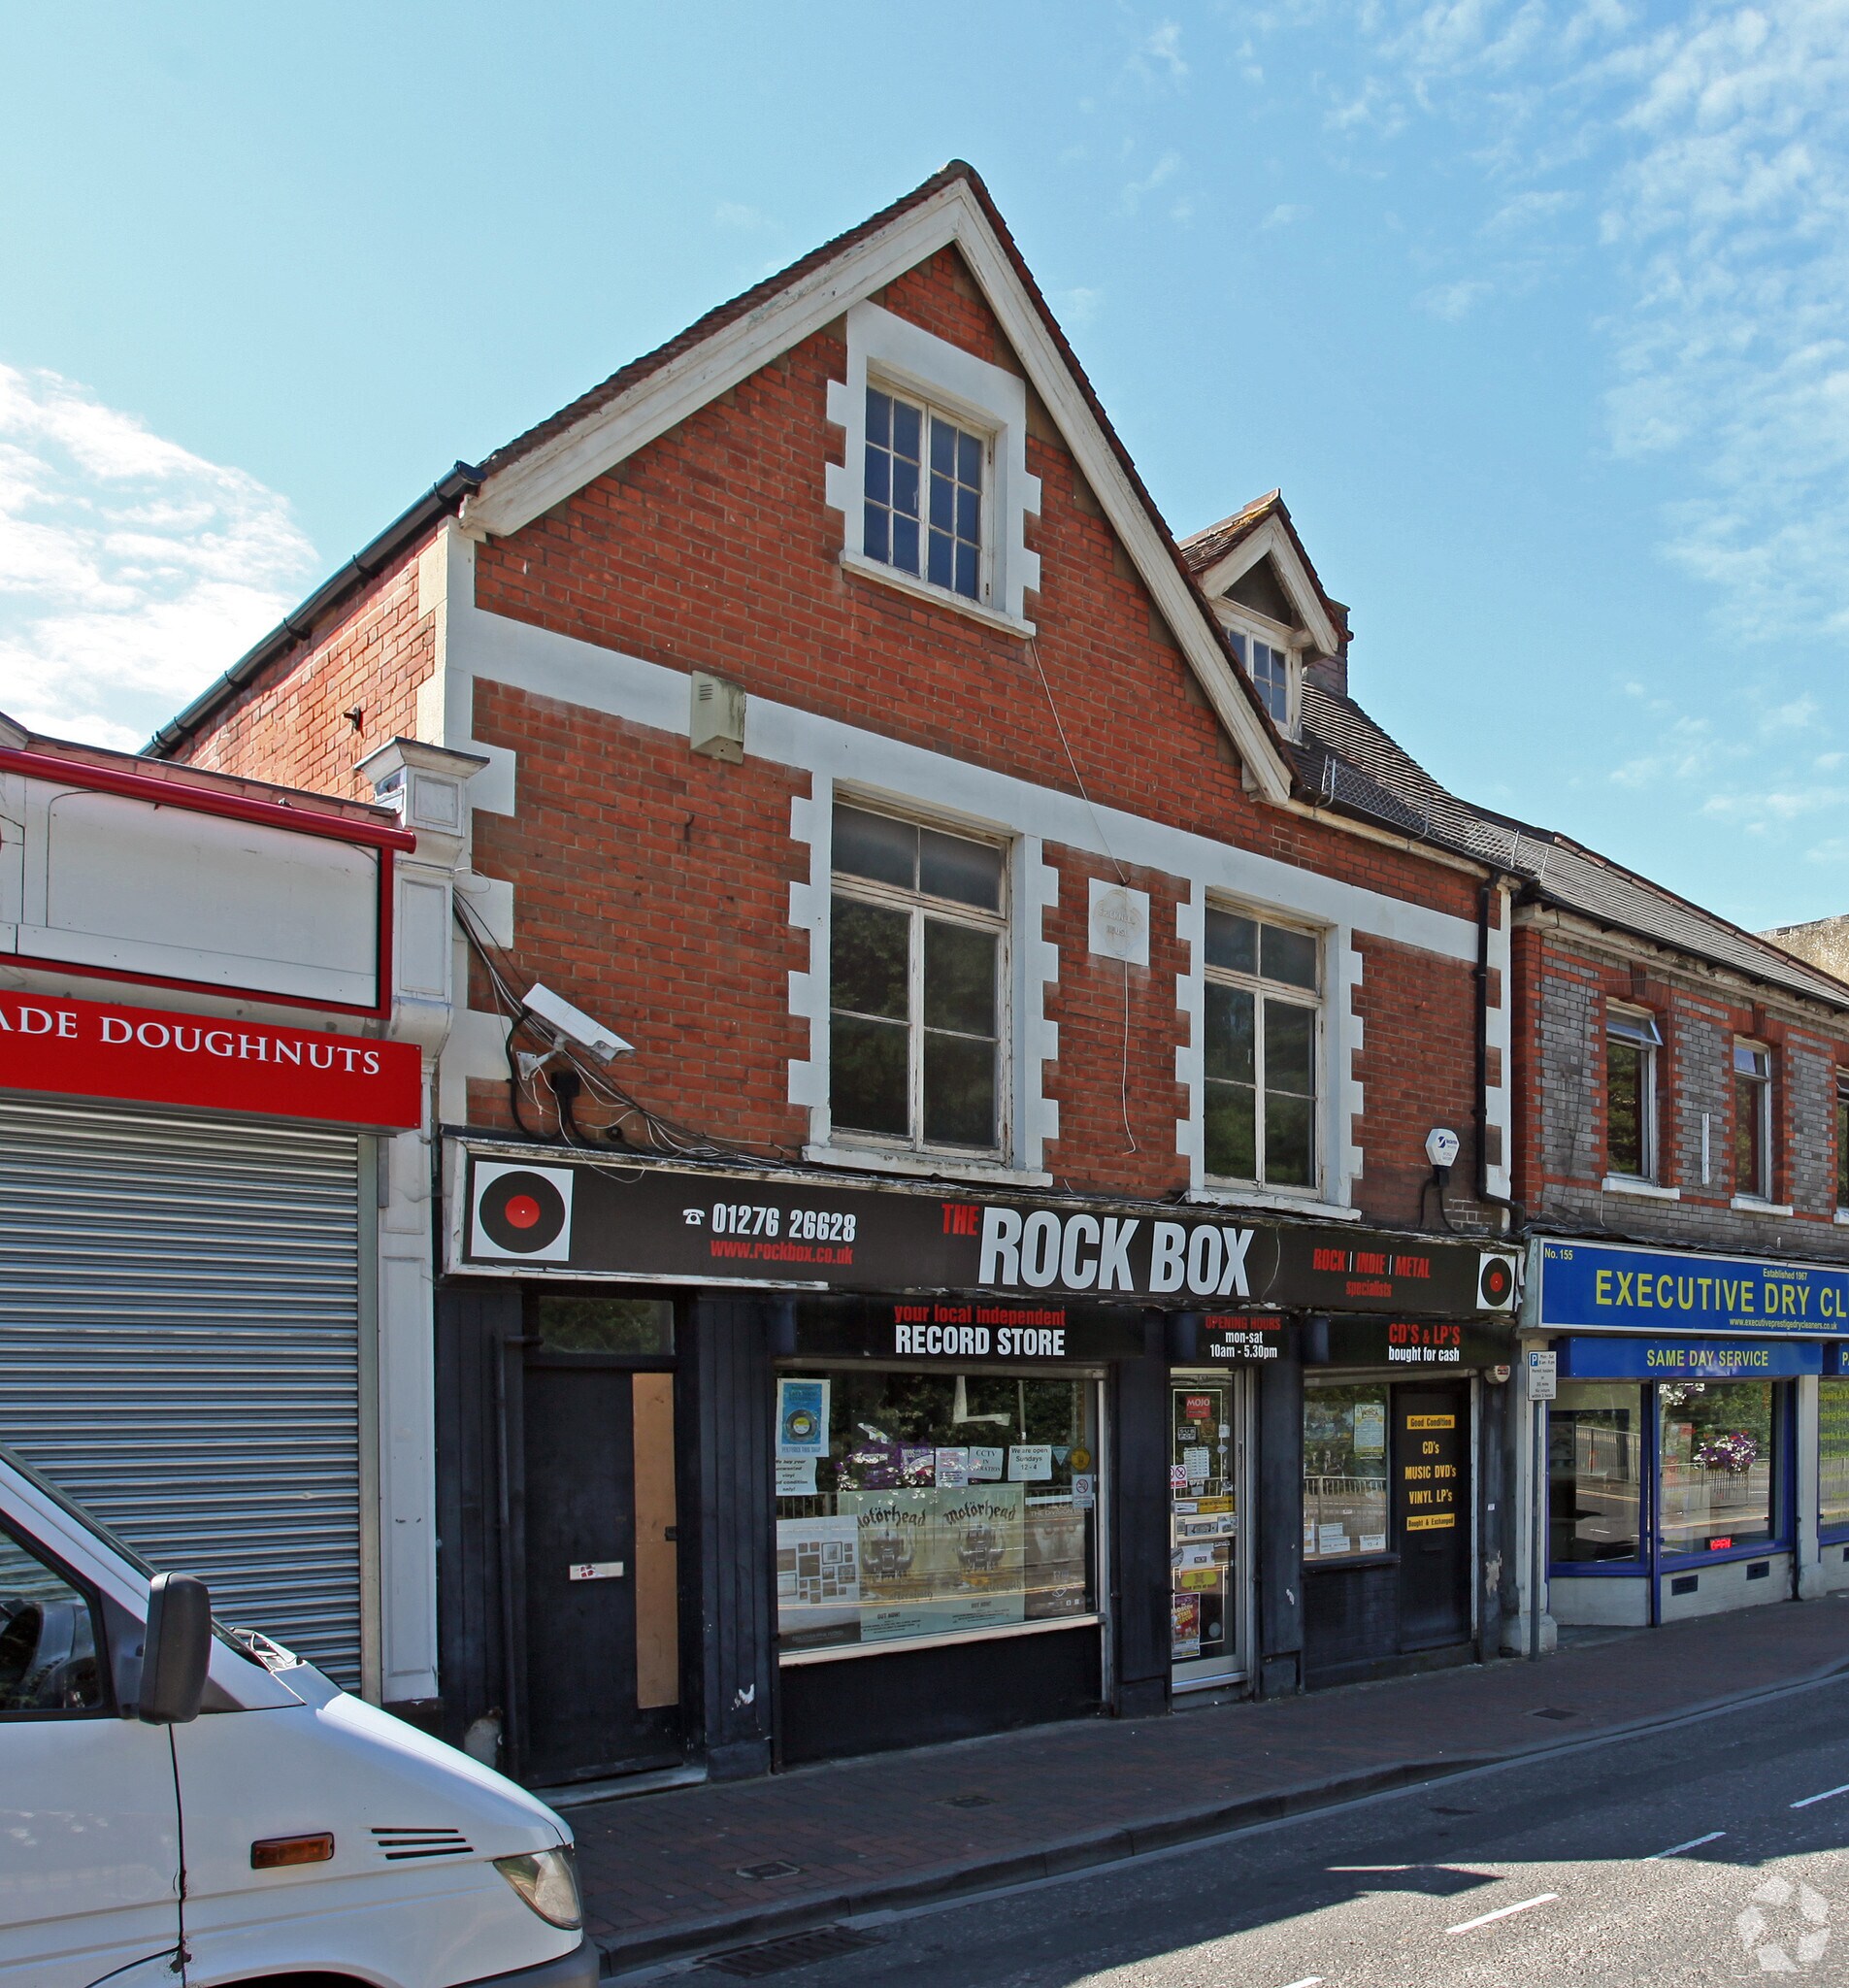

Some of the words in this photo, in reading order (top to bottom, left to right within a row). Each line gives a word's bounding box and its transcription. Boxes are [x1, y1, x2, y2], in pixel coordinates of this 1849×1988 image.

[100, 1016, 380, 1075] DOUGHNUTS
[712, 1203, 779, 1237] 01276
[788, 1209, 856, 1242] 26628
[710, 1241, 853, 1265] www.rockbox.co.uk
[941, 1204, 978, 1236] THE
[978, 1207, 1139, 1291] ROCK
[1149, 1221, 1254, 1297] BOX
[1544, 1247, 1558, 1259] No.
[1560, 1249, 1572, 1260] 155
[1312, 1248, 1345, 1272] ROCK
[1356, 1251, 1385, 1274] INDIE
[1395, 1255, 1431, 1278] METAL
[1763, 1268, 1795, 1279] Established
[1345, 1279, 1392, 1298] specialists
[1596, 1270, 1754, 1312] EXECUTIVE
[1765, 1282, 1810, 1315] DRY
[894, 1307, 930, 1324] your
[934, 1304, 971, 1323] local
[975, 1305, 1065, 1327] independent
[1205, 1315, 1247, 1330] OPENING
[1250, 1316, 1281, 1330] HOURS
[895, 1325, 990, 1355] RECORD
[997, 1327, 1065, 1356] STORE
[1225, 1331, 1263, 1344] mon-sat
[1389, 1323, 1419, 1344] CD'S
[1422, 1329, 1430, 1343] &
[1434, 1325, 1460, 1344] LP'S
[1210, 1344, 1236, 1358] 10am
[1243, 1345, 1277, 1359] 5.30pm
[1389, 1346, 1421, 1363] bought
[1423, 1346, 1436, 1361] for
[1437, 1346, 1460, 1362] cash
[1532, 1355, 1537, 1365] P
[1647, 1349, 1685, 1367] SAME
[1689, 1350, 1714, 1367] DAY
[1718, 1350, 1768, 1367] SERVICE
[1410, 1418, 1424, 1427] Good
[1426, 1418, 1452, 1427] Condition
[1422, 1441, 1439, 1454] CD's
[1404, 1466, 1431, 1480] MUSIC
[1435, 1465, 1456, 1478] DVD's
[1408, 1490, 1433, 1505] VINYL
[1436, 1489, 1453, 1503] LP's
[1408, 1519, 1423, 1528] Bought
[1432, 1516, 1454, 1526] Exchanged
